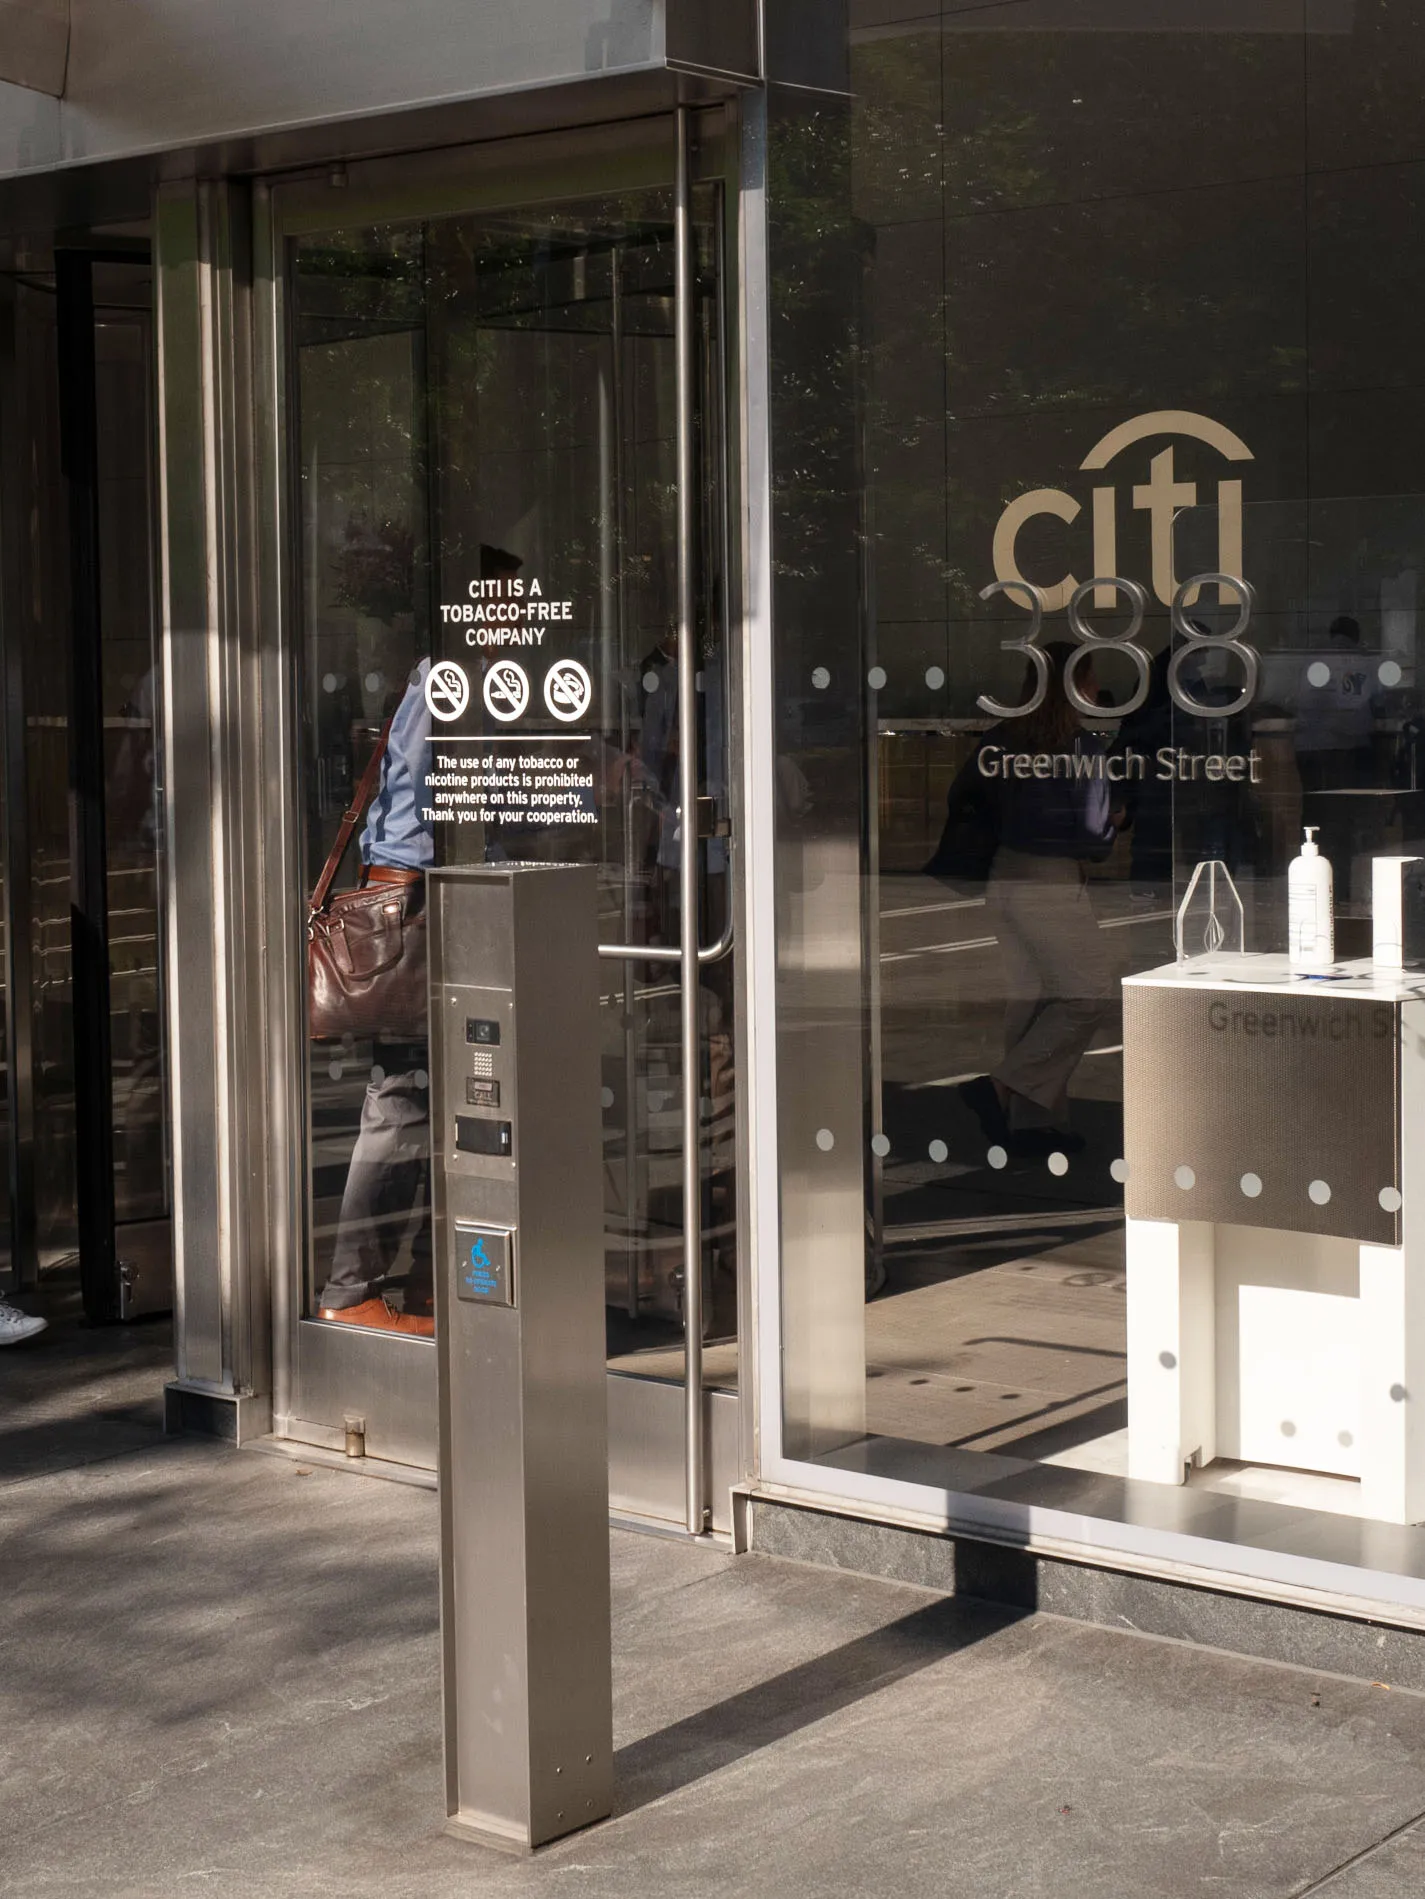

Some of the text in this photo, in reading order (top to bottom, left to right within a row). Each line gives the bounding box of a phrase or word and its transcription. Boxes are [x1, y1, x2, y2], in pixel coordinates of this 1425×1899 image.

[992, 445, 1243, 612] citi
[468, 578, 542, 598] CITI IS A
[440, 602, 573, 623] TOBACCO-FREE
[465, 627, 546, 646] COMPANY
[977, 573, 1262, 718] 388
[437, 755, 580, 772] The use of any tobacco or
[977, 745, 1262, 783] Greenwich Street
[424, 772, 594, 789] nicotine products is prohibited
[434, 791, 583, 807] anywhere on this property.
[421, 807, 599, 826] Thank you for your cooperation.
